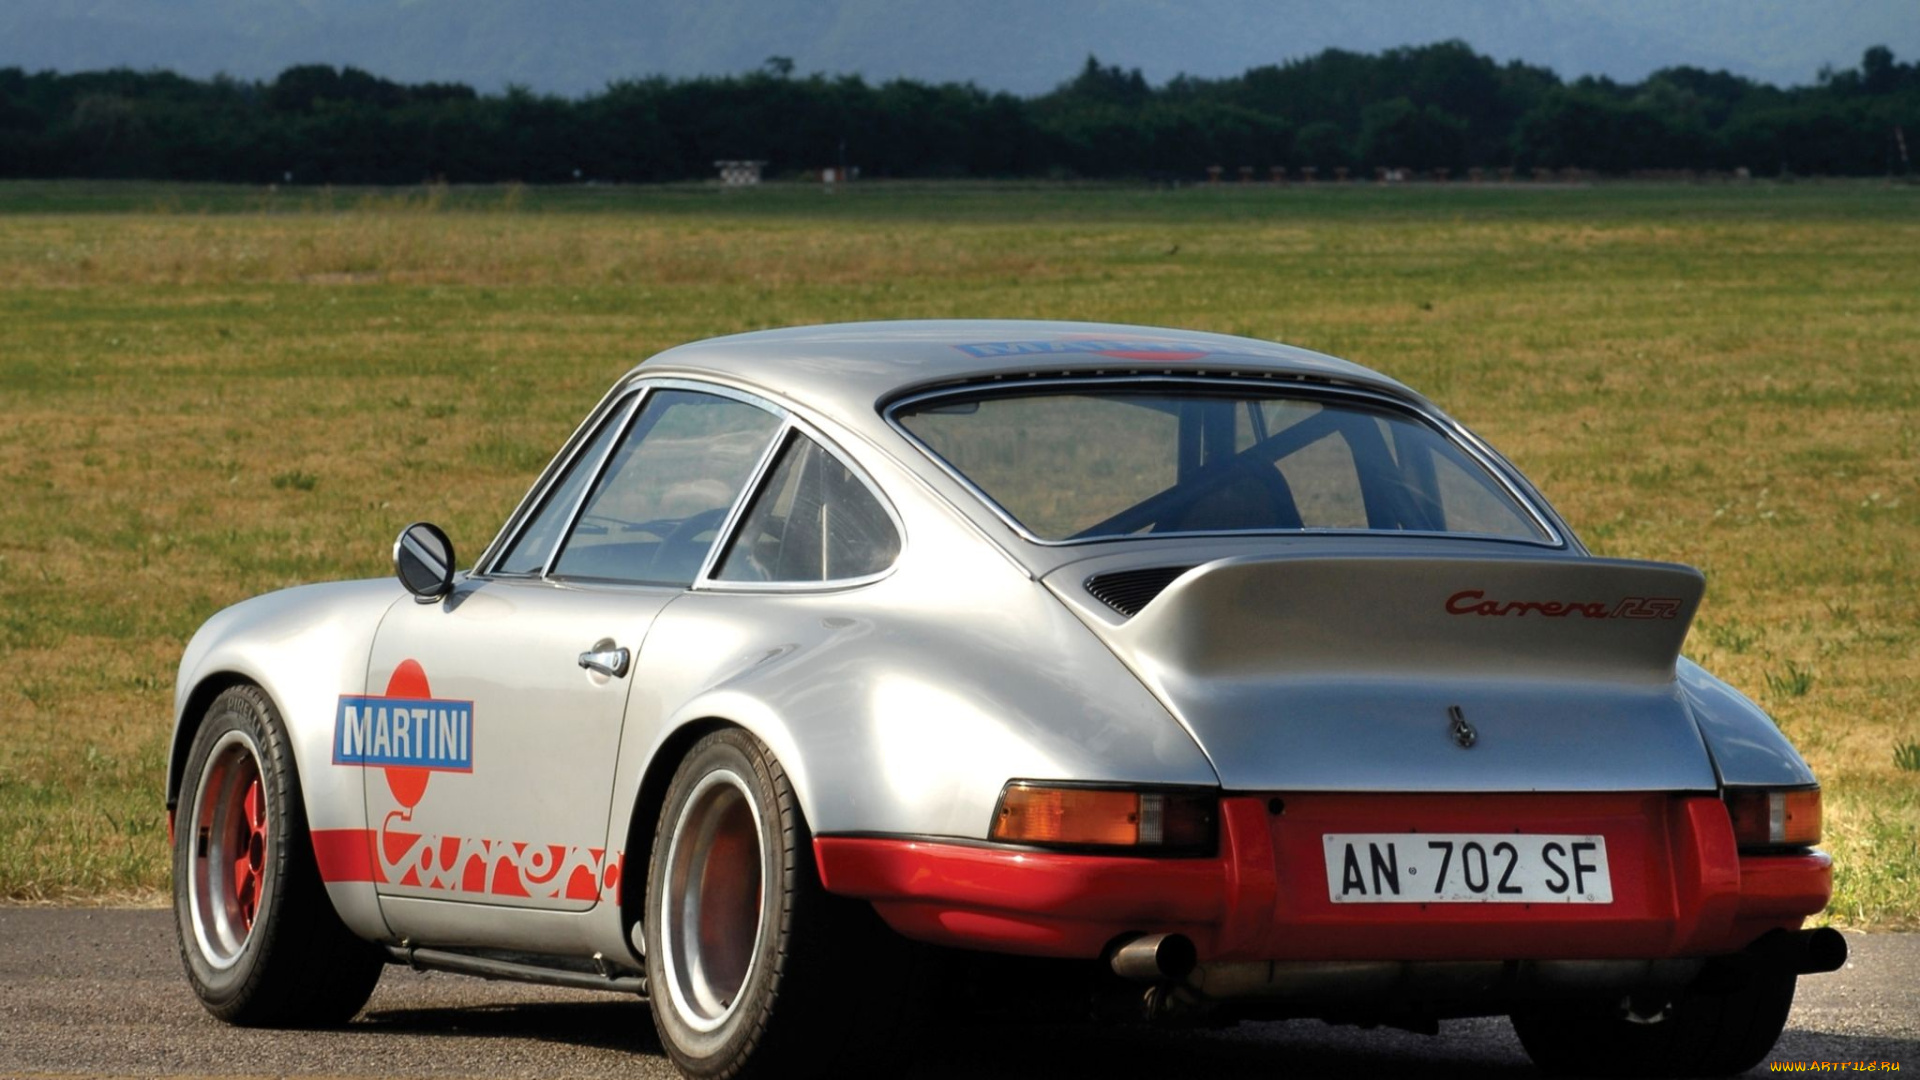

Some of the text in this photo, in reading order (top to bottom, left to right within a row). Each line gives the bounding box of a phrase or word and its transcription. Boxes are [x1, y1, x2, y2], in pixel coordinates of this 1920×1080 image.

[1445, 590, 1608, 619] Carrera
[342, 705, 468, 762] MARTINI
[1342, 841, 1597, 895] AN 702 SF
